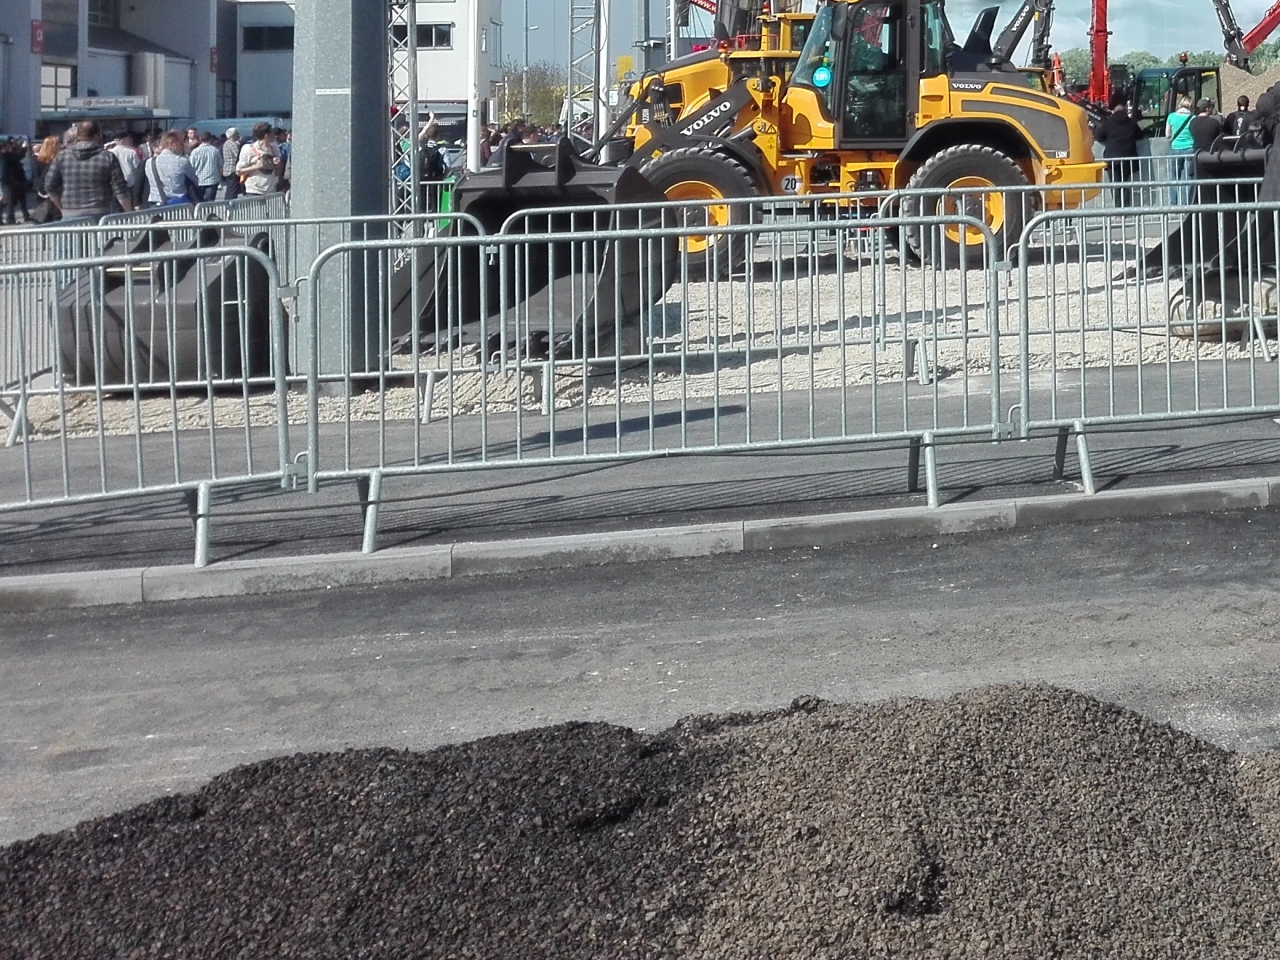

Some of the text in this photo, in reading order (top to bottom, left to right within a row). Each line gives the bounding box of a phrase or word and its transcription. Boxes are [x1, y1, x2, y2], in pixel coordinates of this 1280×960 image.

[1010, 5, 1030, 31] VOLVO
[680, 101, 731, 136] VOLVO
[784, 177, 797, 191] 20
